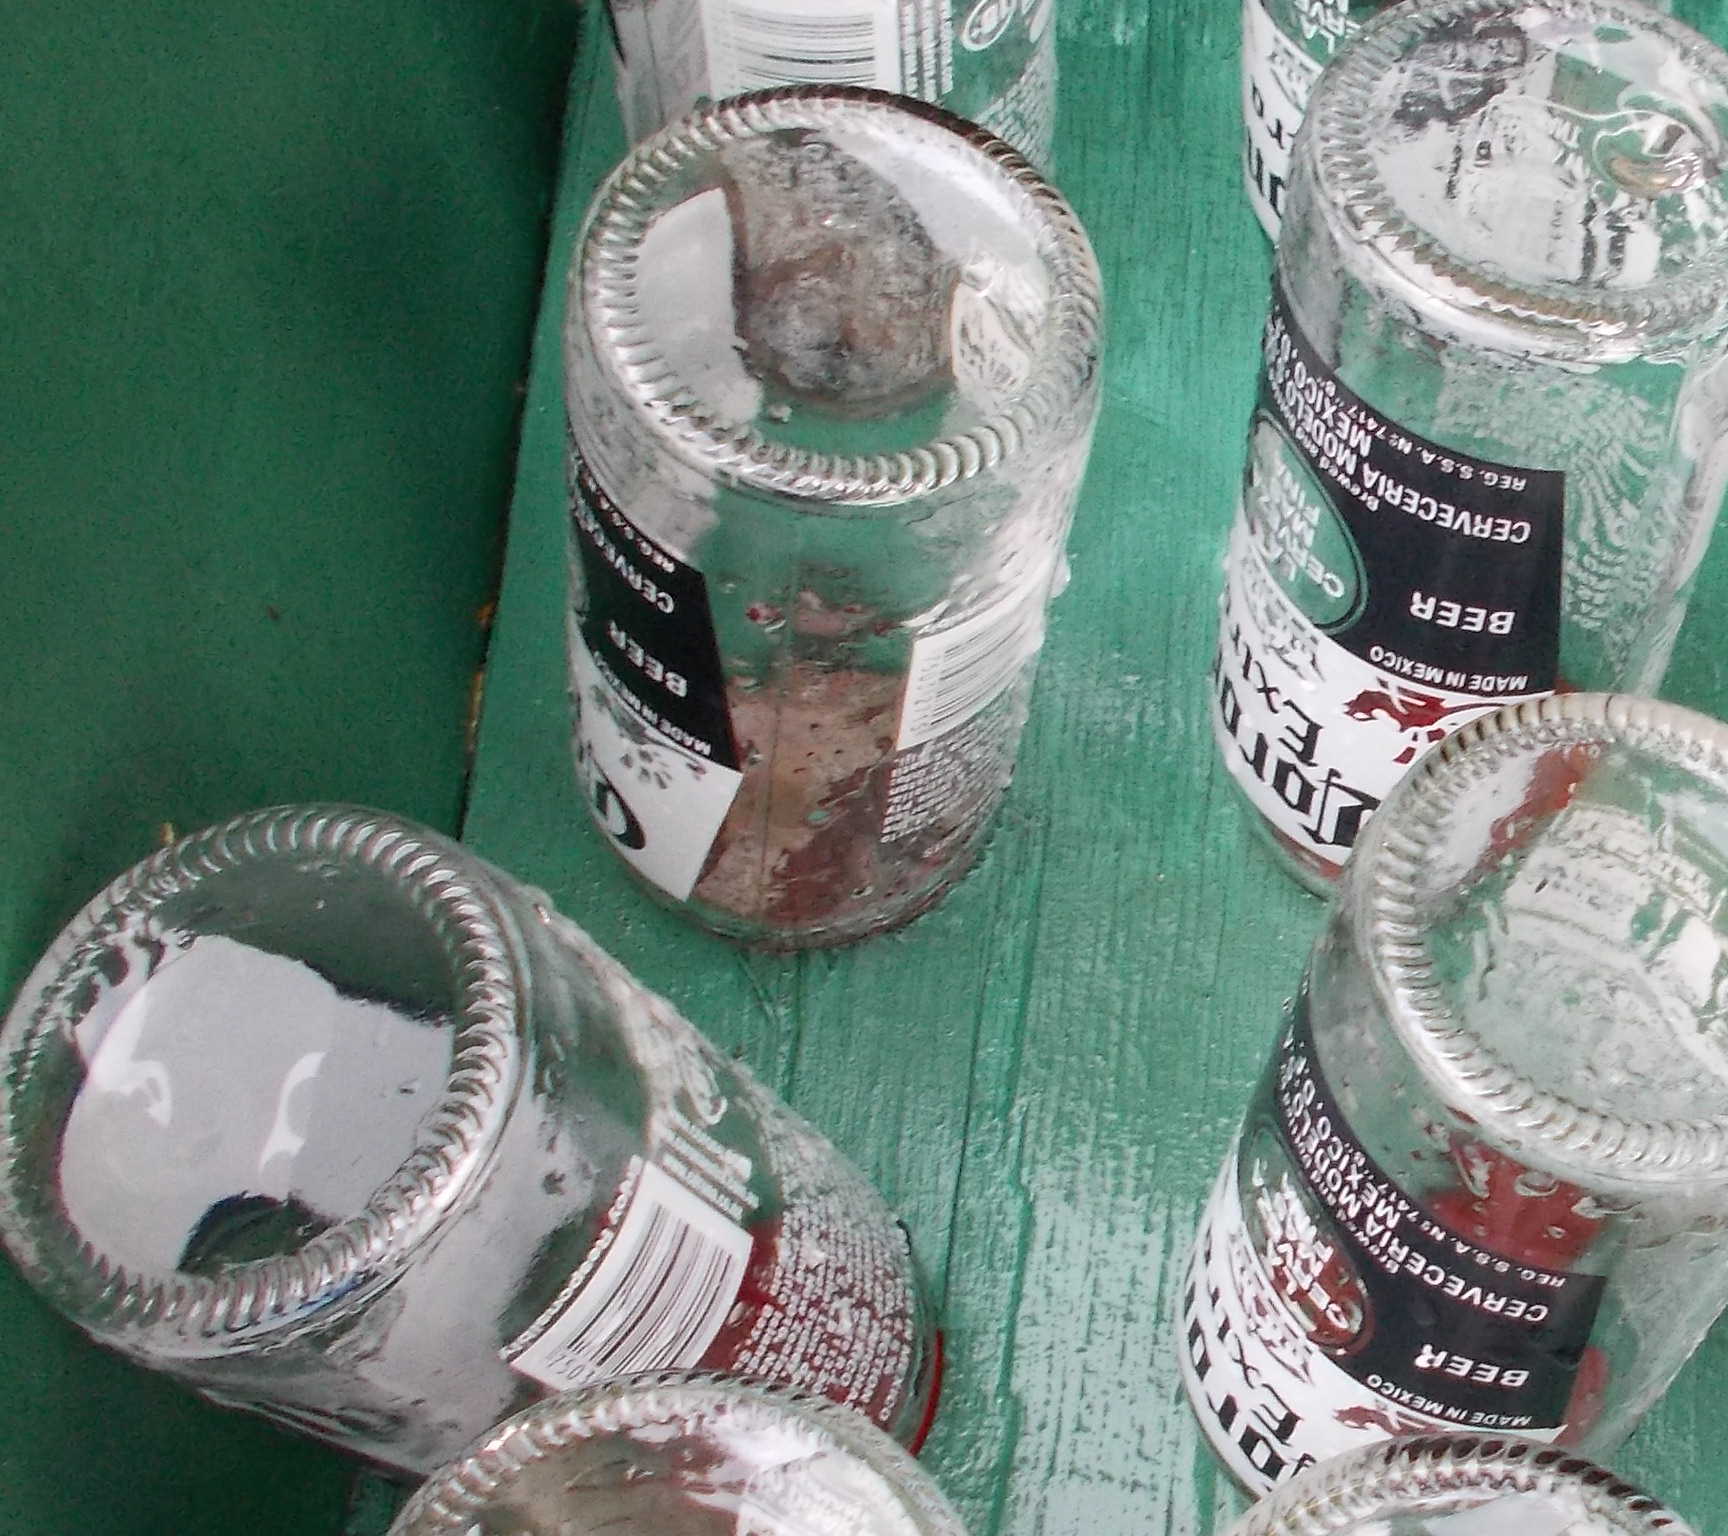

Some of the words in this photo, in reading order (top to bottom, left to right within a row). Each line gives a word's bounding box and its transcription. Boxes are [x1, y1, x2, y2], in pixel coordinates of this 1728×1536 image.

[1416, 447, 1473, 479] S.S.A.
[1479, 470, 1526, 491] REG.
[1363, 463, 1531, 543] CERVECERIA
[1409, 591, 1515, 635] BEER
[608, 621, 687, 697] BEER
[1369, 645, 1443, 682] MEXICO
[1446, 672, 1466, 687] IN
[1470, 674, 1528, 690] MADE
[1365, 1213, 1548, 1322] CERVECERIA
[1414, 1344, 1529, 1387] BEER
[1366, 1373, 1444, 1415] MEXICO
[1447, 1406, 1467, 1420] IN
[1472, 1411, 1532, 1426] MADE
